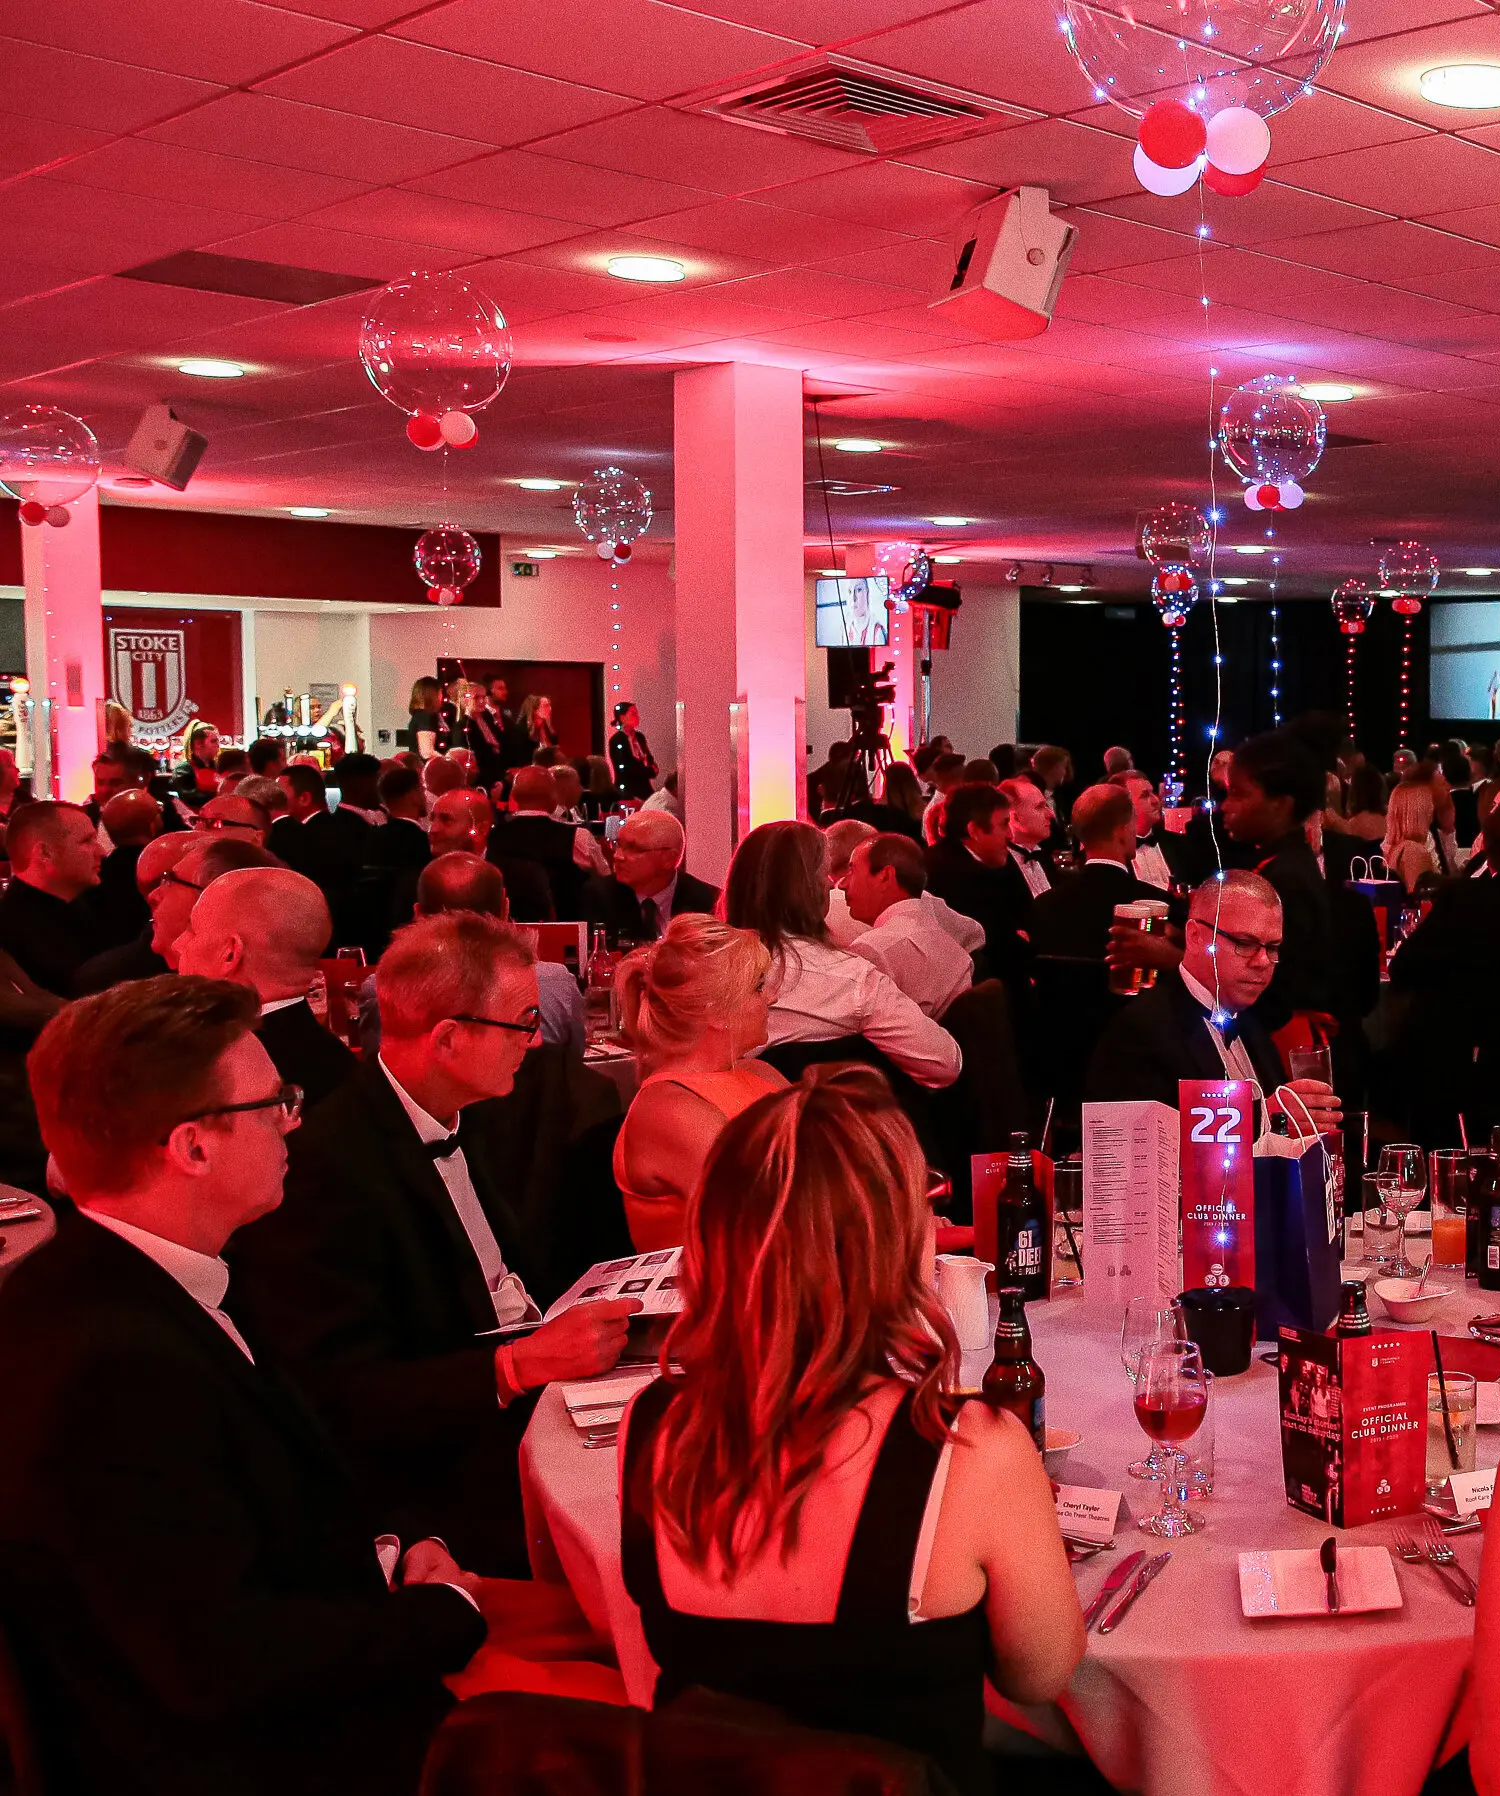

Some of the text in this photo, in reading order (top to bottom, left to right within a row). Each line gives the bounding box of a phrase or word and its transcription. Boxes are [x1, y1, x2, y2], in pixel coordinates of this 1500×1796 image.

[116, 636, 179, 651] STOKE
[132, 651, 164, 661] CITY
[1190, 1106, 1241, 1143] 22
[1186, 1212, 1209, 1220] CLUB
[1018, 1230, 1033, 1248] 61
[1361, 1411, 1409, 1427] OFFICIAL
[1351, 1420, 1419, 1439] CLUB DINNER
[1471, 1485, 1489, 1493] Nicola
[1062, 1501, 1100, 1512] Cheryl Taylor
